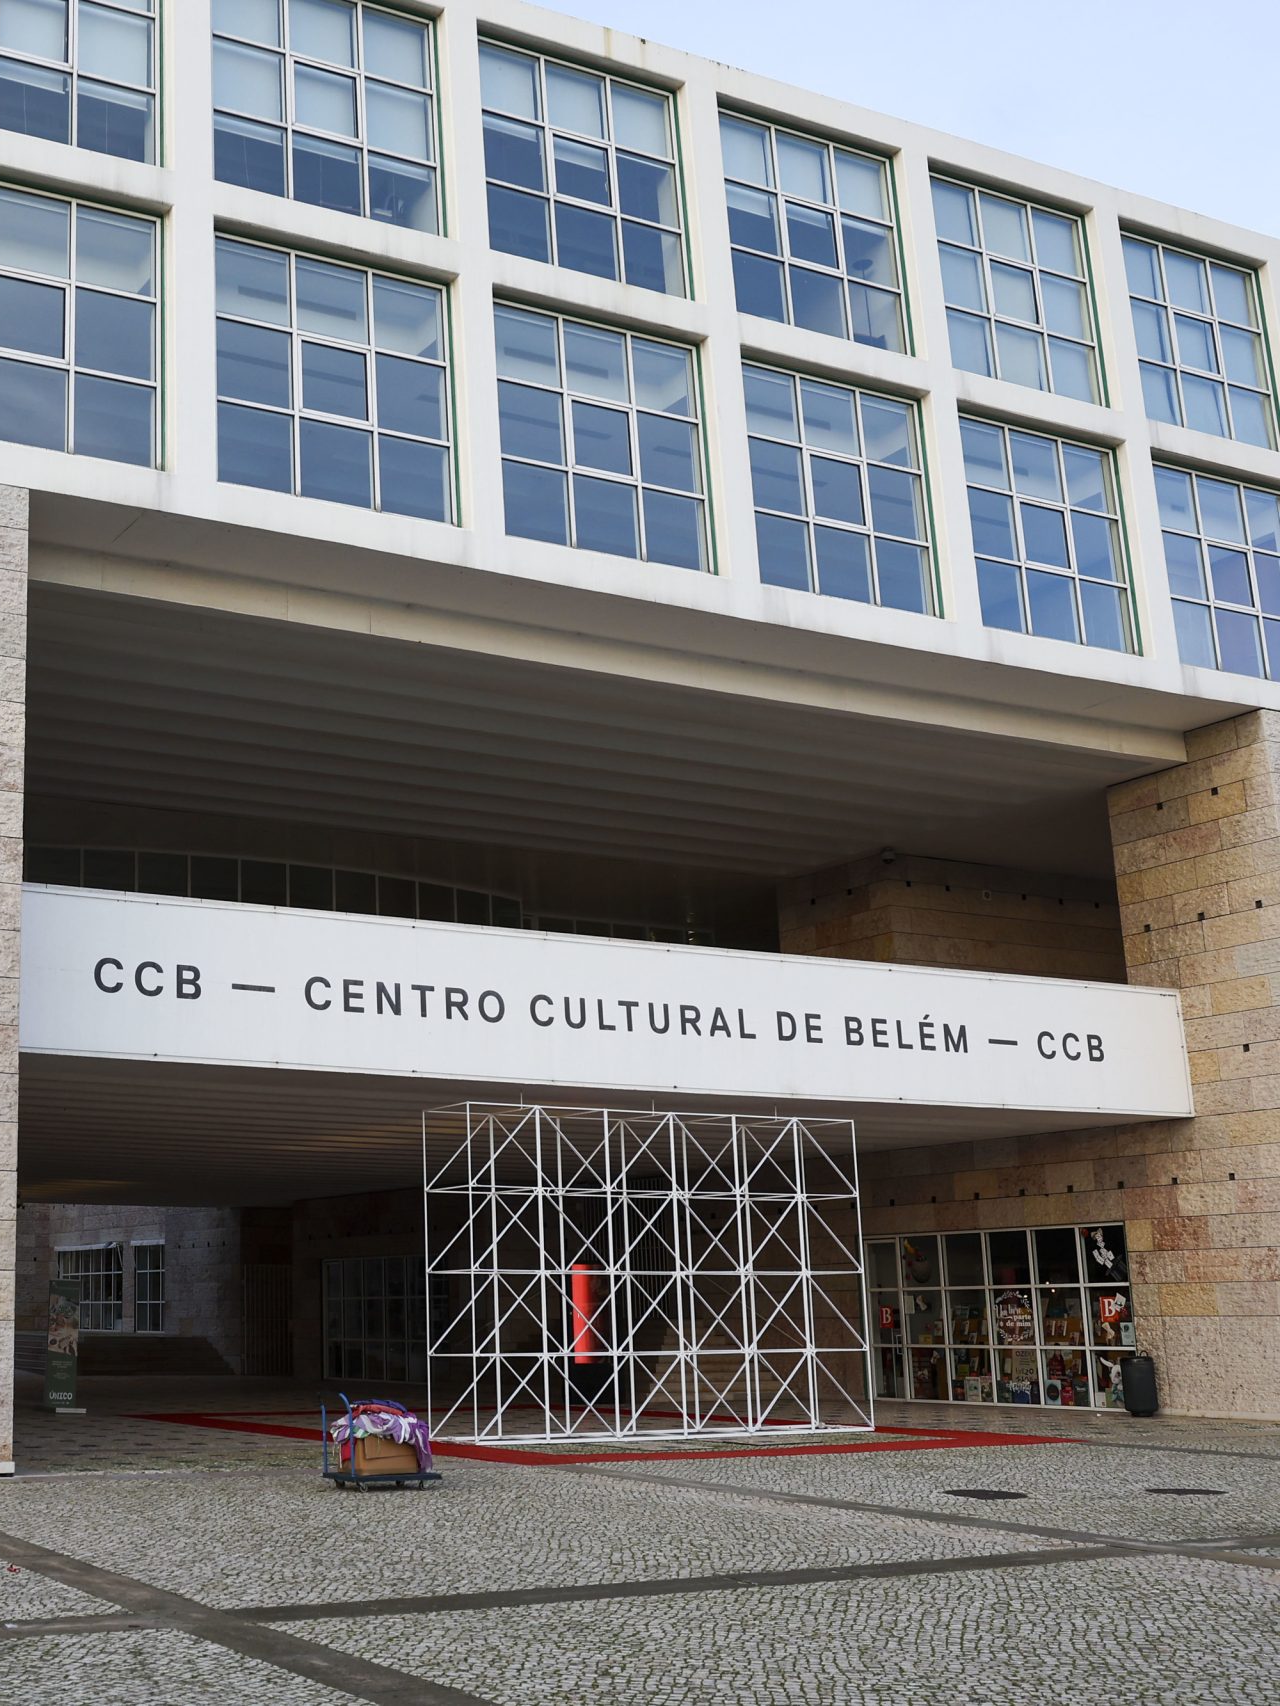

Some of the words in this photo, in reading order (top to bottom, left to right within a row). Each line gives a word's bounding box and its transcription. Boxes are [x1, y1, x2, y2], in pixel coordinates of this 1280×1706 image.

[94, 957, 202, 1000] CCB
[304, 976, 506, 1024] CENTRO
[529, 994, 757, 1040] CULTURAL
[776, 1010, 824, 1044] DE
[844, 1013, 969, 1054] BELÉM
[1037, 1030, 1105, 1063] CCB
[881, 1307, 892, 1324] B
